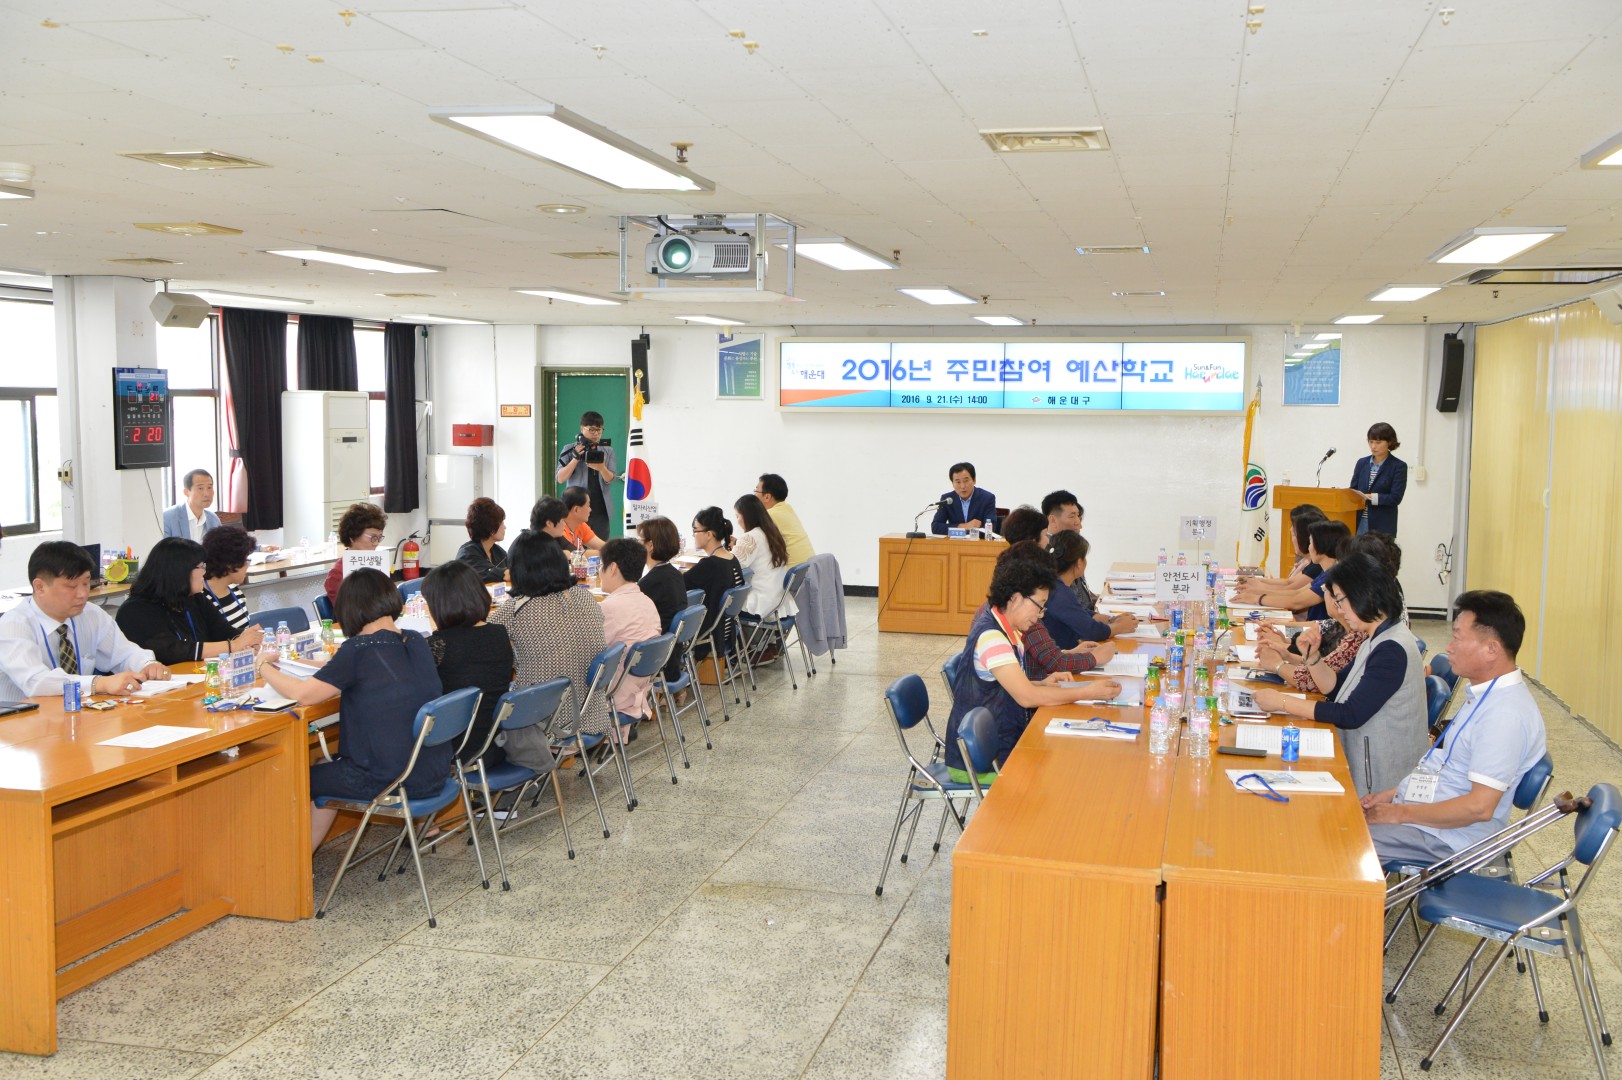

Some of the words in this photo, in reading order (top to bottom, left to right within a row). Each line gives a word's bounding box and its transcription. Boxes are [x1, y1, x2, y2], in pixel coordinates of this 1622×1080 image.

[842, 358, 932, 382] 2016년
[946, 358, 1051, 383] 주민참여
[1066, 359, 1174, 383] 예산학교
[147, 426, 162, 442] 20
[349, 555, 383, 566] 주민생활
[1162, 571, 1200, 582] 안전도시
[1171, 584, 1191, 594] 분과
